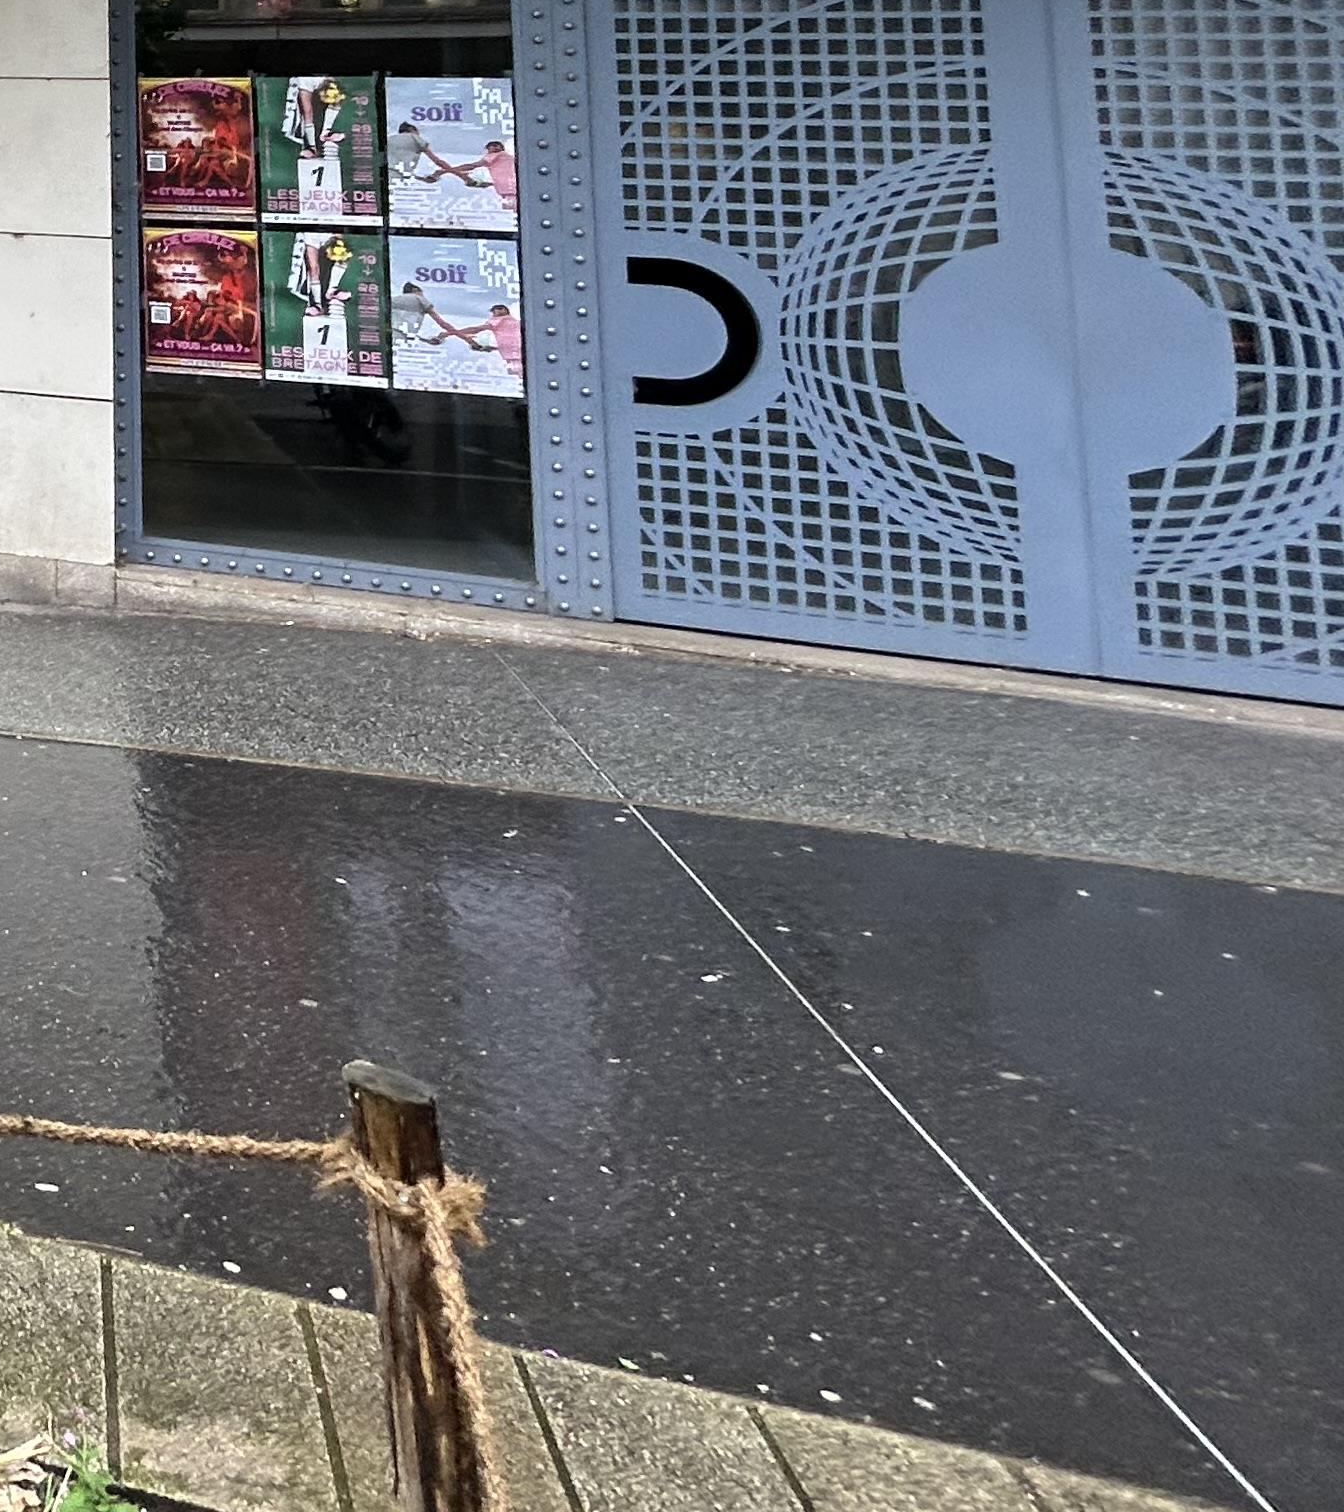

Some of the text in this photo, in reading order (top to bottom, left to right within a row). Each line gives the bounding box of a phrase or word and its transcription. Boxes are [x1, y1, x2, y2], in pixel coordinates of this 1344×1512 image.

[412, 102, 463, 121] soif
[312, 166, 324, 186] 1
[267, 189, 376, 202] LES JEUX DE
[267, 201, 352, 213] BRETAGNE
[415, 264, 468, 284] soif
[317, 324, 330, 345] 1
[271, 346, 382, 363] LES JEUX DE
[271, 357, 358, 374] BRETAGNE
